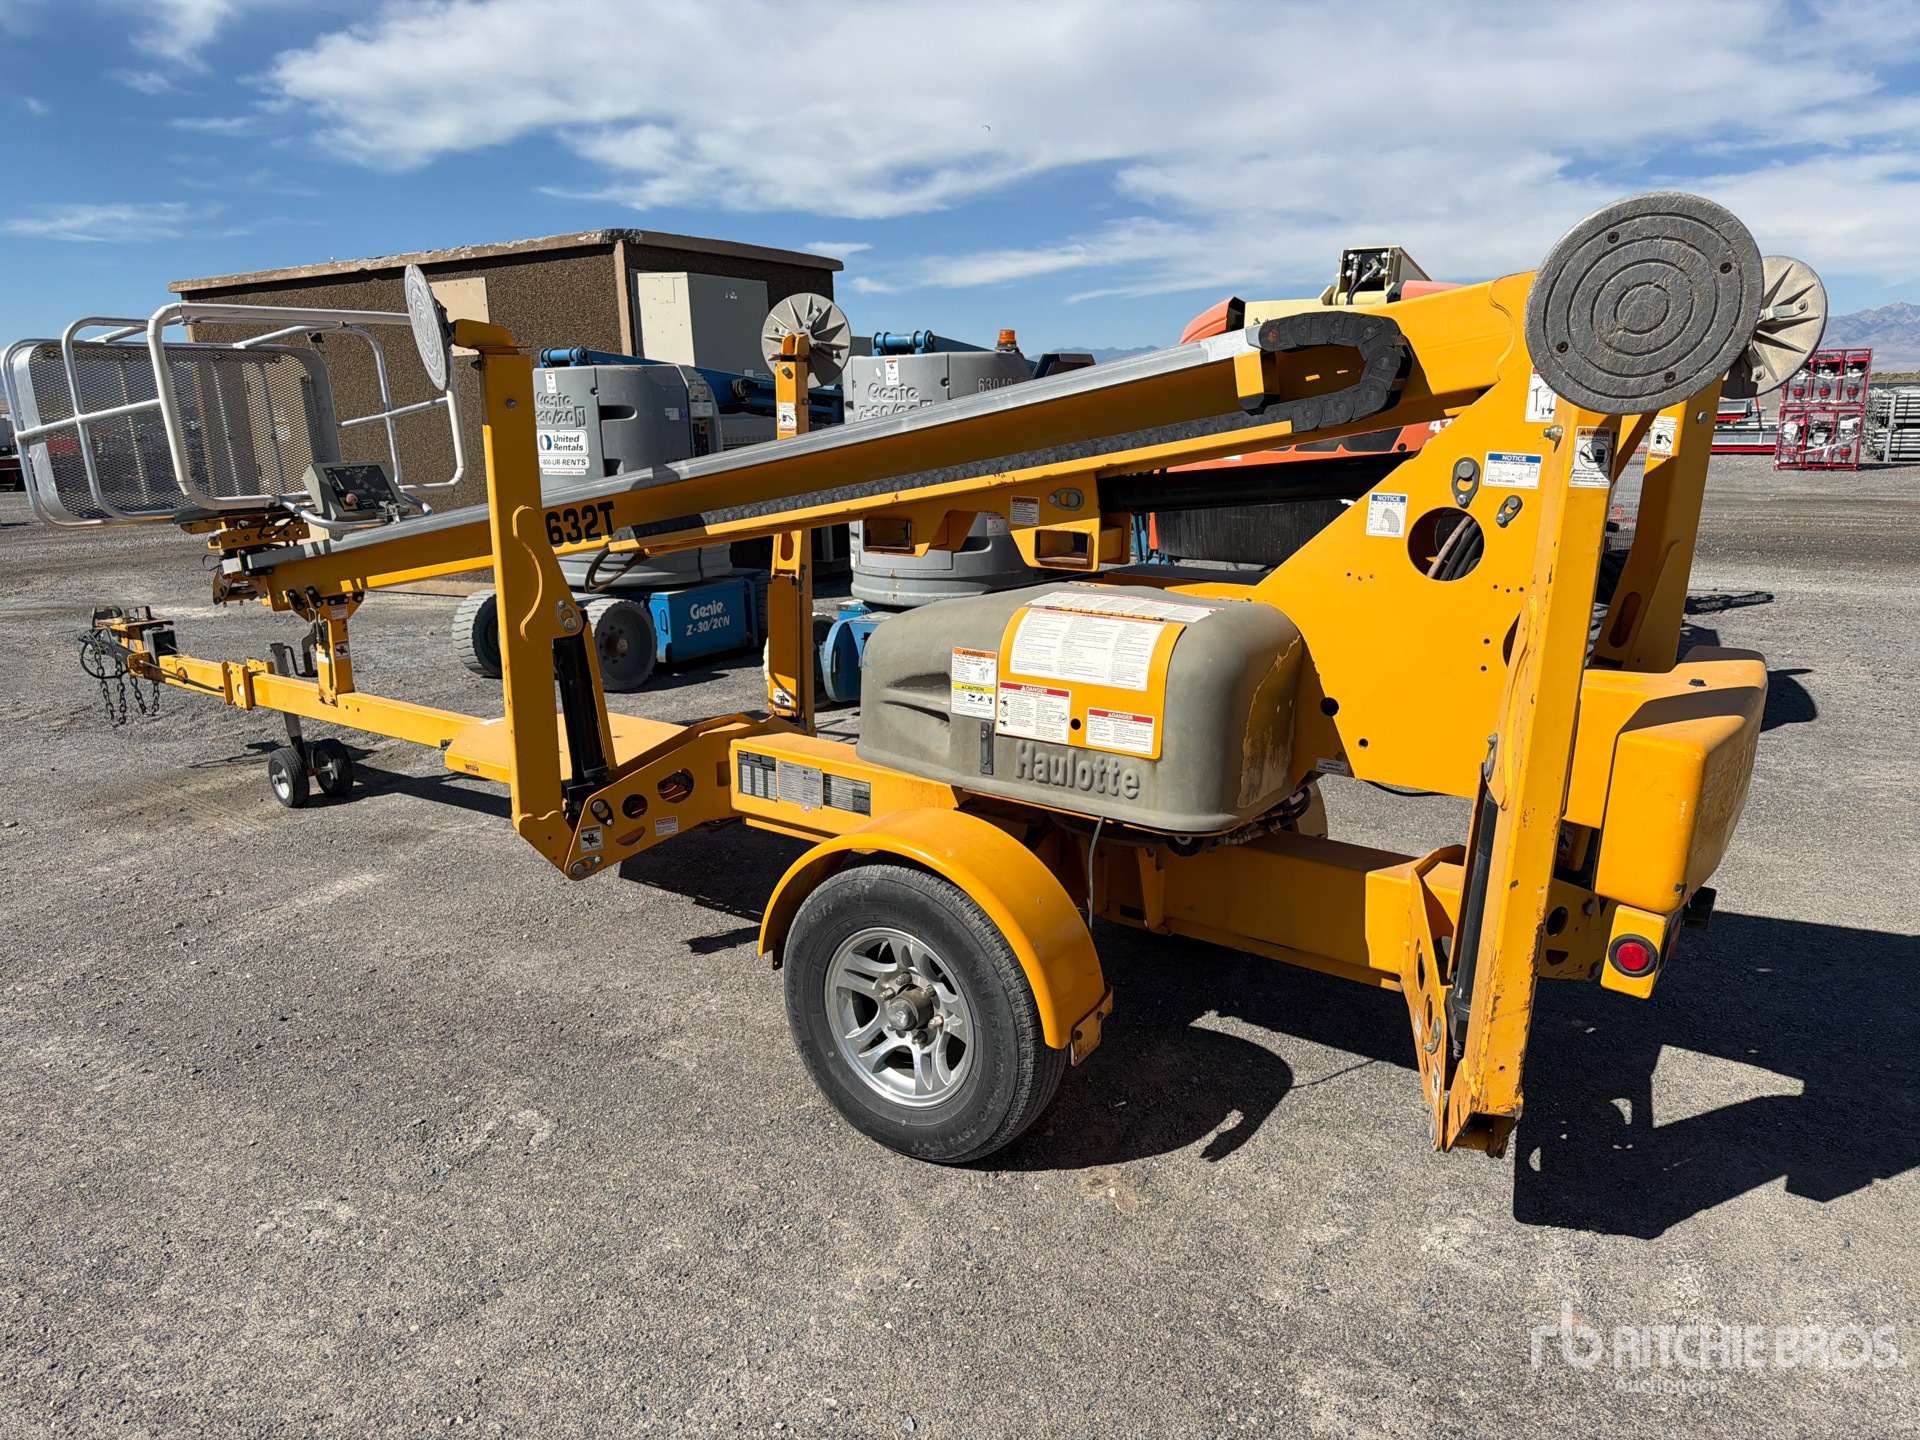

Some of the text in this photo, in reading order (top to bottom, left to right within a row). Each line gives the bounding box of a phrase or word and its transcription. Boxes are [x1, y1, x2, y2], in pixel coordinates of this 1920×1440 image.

[536, 391, 573, 409] Genie
[868, 382, 919, 403] Genie
[536, 405, 587, 428] -30/20N
[553, 434, 580, 443] United
[553, 443, 584, 452] Rentals
[1502, 454, 1527, 462] NOTICE
[690, 599, 724, 620] Genie
[686, 614, 731, 637] Z-30/20N
[1025, 686, 1048, 694] DANGER
[1112, 712, 1134, 720] DANGER
[1015, 740, 1140, 800] Haulotte
